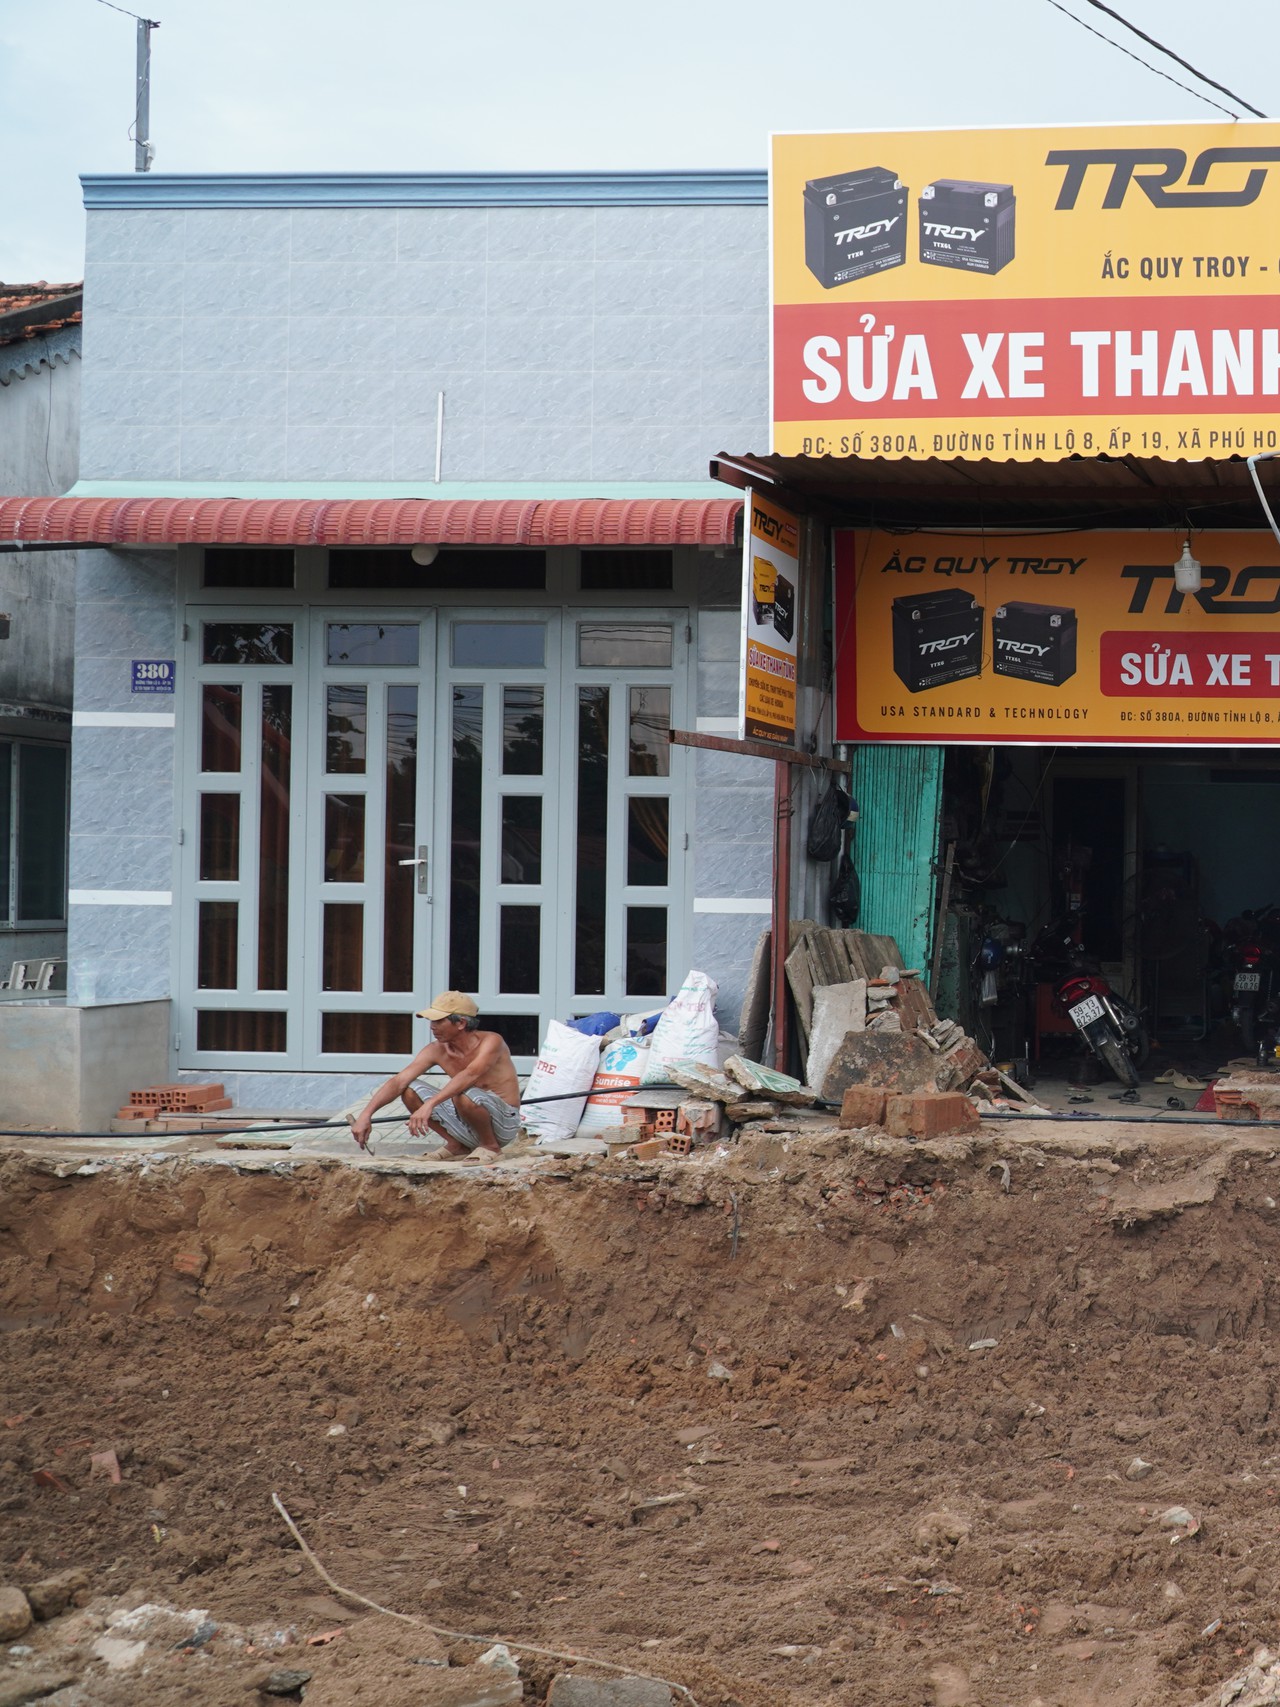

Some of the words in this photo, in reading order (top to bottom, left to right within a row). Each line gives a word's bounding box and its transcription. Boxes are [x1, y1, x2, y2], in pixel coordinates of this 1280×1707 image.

[834, 216, 900, 246] TROY
[923, 222, 986, 242] TROY
[1101, 249, 1130, 279] ẮC
[1140, 256, 1184, 281] QUY
[1192, 255, 1251, 278] TROY
[801, 313, 938, 404] SỬA
[961, 331, 1045, 399] XE
[802, 437, 832, 455] ĐC:
[840, 430, 866, 454] SỐ
[870, 434, 925, 454] 380A,
[933, 430, 995, 452] ĐƯỜNG
[1002, 427, 1046, 451] TỈNH
[1054, 429, 1076, 454] LỘ
[1083, 432, 1100, 453] 8,
[1108, 427, 1132, 450] ẤP
[1141, 431, 1169, 452] 19,
[1177, 428, 1202, 449] XÃ
[1209, 427, 1246, 449] PHÚ
[753, 506, 784, 541] TROY
[881, 548, 927, 573] ẮC
[933, 556, 1001, 577] QUY
[1006, 557, 1088, 575] TROY
[919, 632, 976, 656] TROY
[996, 638, 1051, 657] TROY
[136, 663, 170, 679] 380
[1120, 643, 1194, 686] SỬA
[1205, 653, 1251, 686] XE
[881, 705, 905, 717] USA
[913, 706, 981, 718] STANDARD
[989, 708, 996, 718] &
[1005, 707, 1089, 720] TECHNOLOGY
[1120, 711, 1136, 721] ĐC:
[1140, 709, 1152, 721] SỐ
[1155, 711, 1184, 723] 380A,
[1187, 710, 1220, 722] ĐƯỜNG
[1224, 710, 1246, 723] TỈNH
[1250, 711, 1261, 724] LỘ
[595, 1076, 631, 1087] Sunrise
